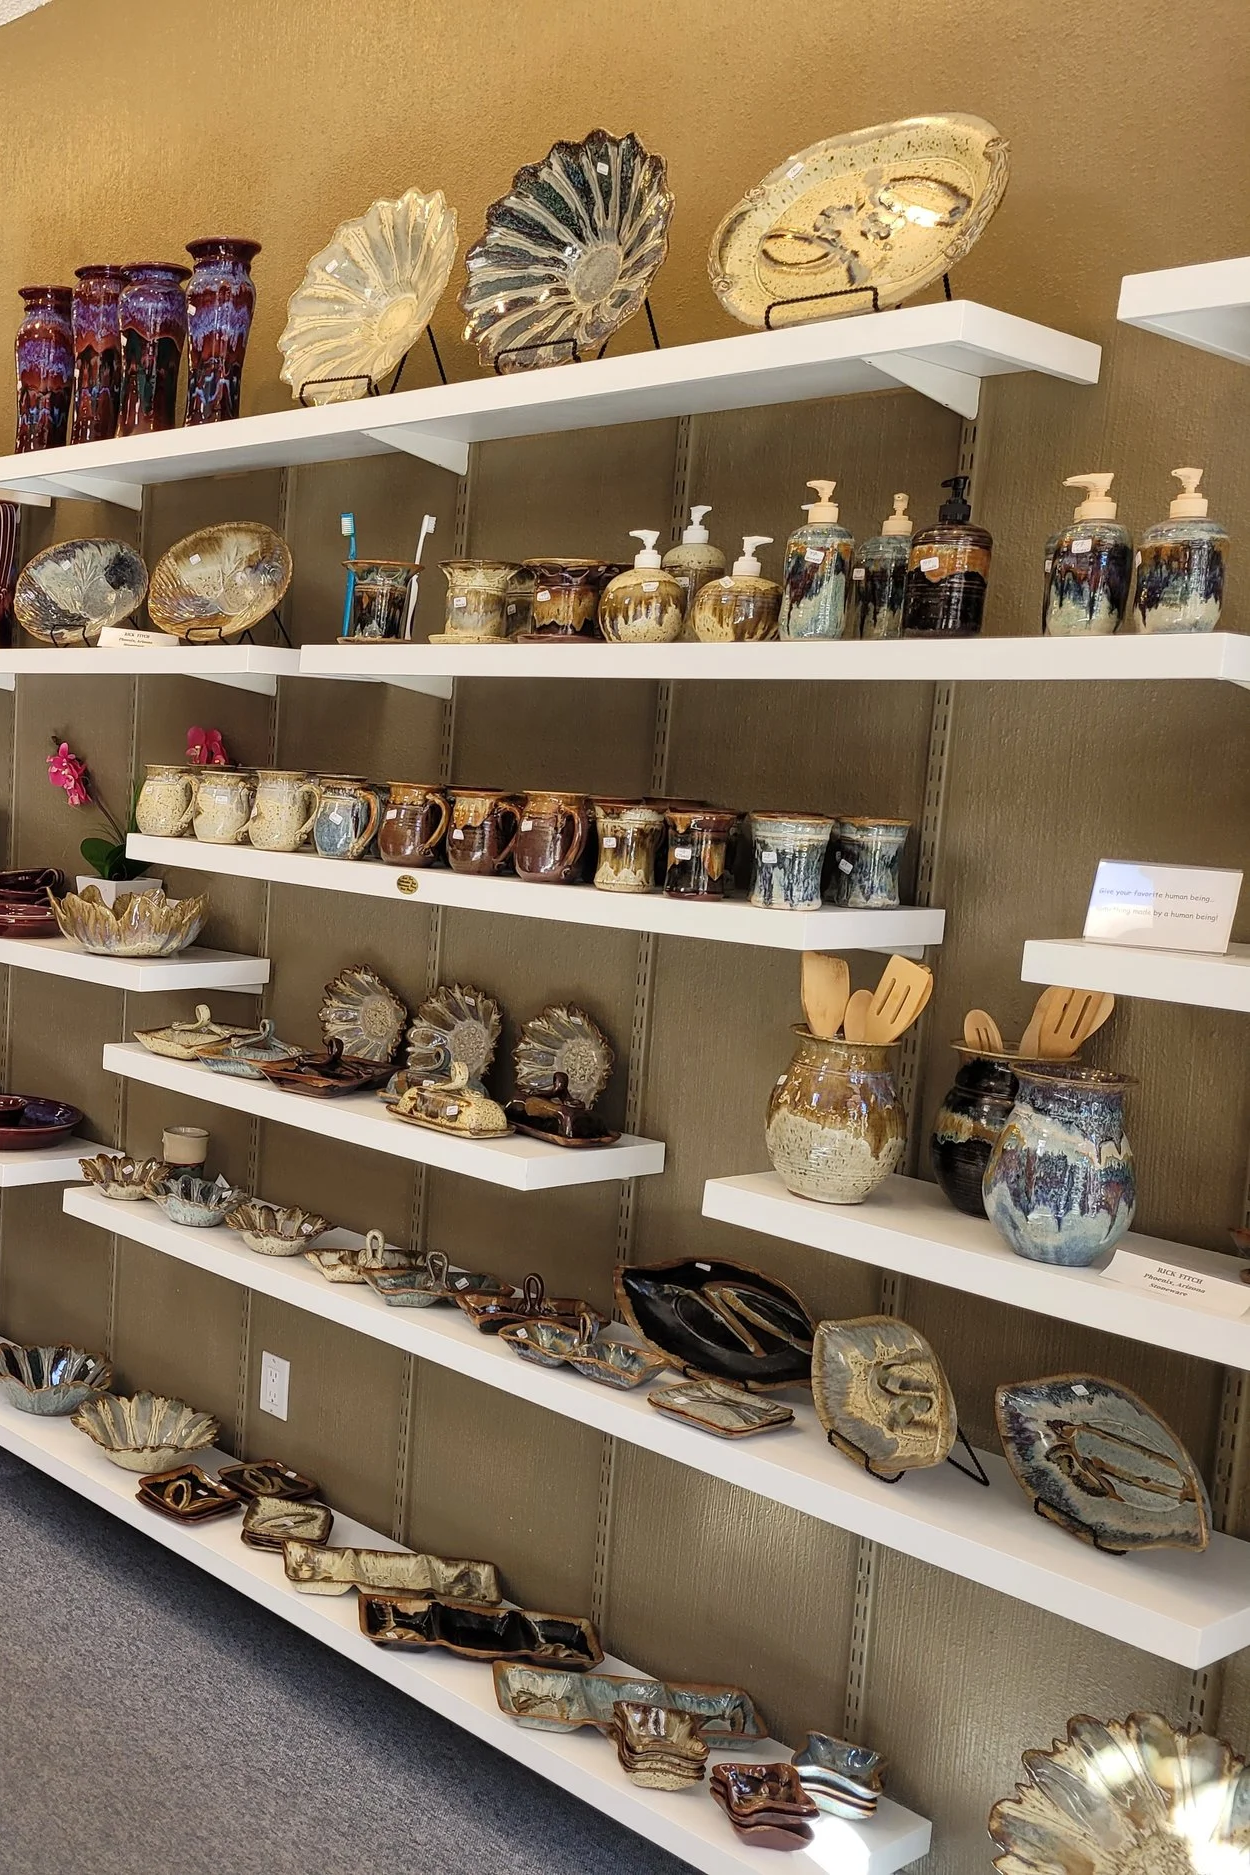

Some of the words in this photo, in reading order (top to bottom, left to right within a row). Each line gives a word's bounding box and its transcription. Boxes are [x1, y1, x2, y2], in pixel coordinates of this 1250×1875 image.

[1098, 887, 1114, 895] Give
[1133, 889, 1163, 899] favorite
[1164, 892, 1189, 900] human
[1096, 905, 1131, 916] mething
[1132, 908, 1152, 916] made
[1153, 909, 1163, 918] by
[1170, 910, 1194, 919] human
[1195, 913, 1219, 923] being!
[1143, 1273, 1175, 1286] Phoenix,
[1177, 1282, 1206, 1293] Arizona
[1157, 1267, 1177, 1277] RICK
[1178, 1273, 1203, 1284] FITCH
[1149, 1283, 1188, 1296] Stoneware
